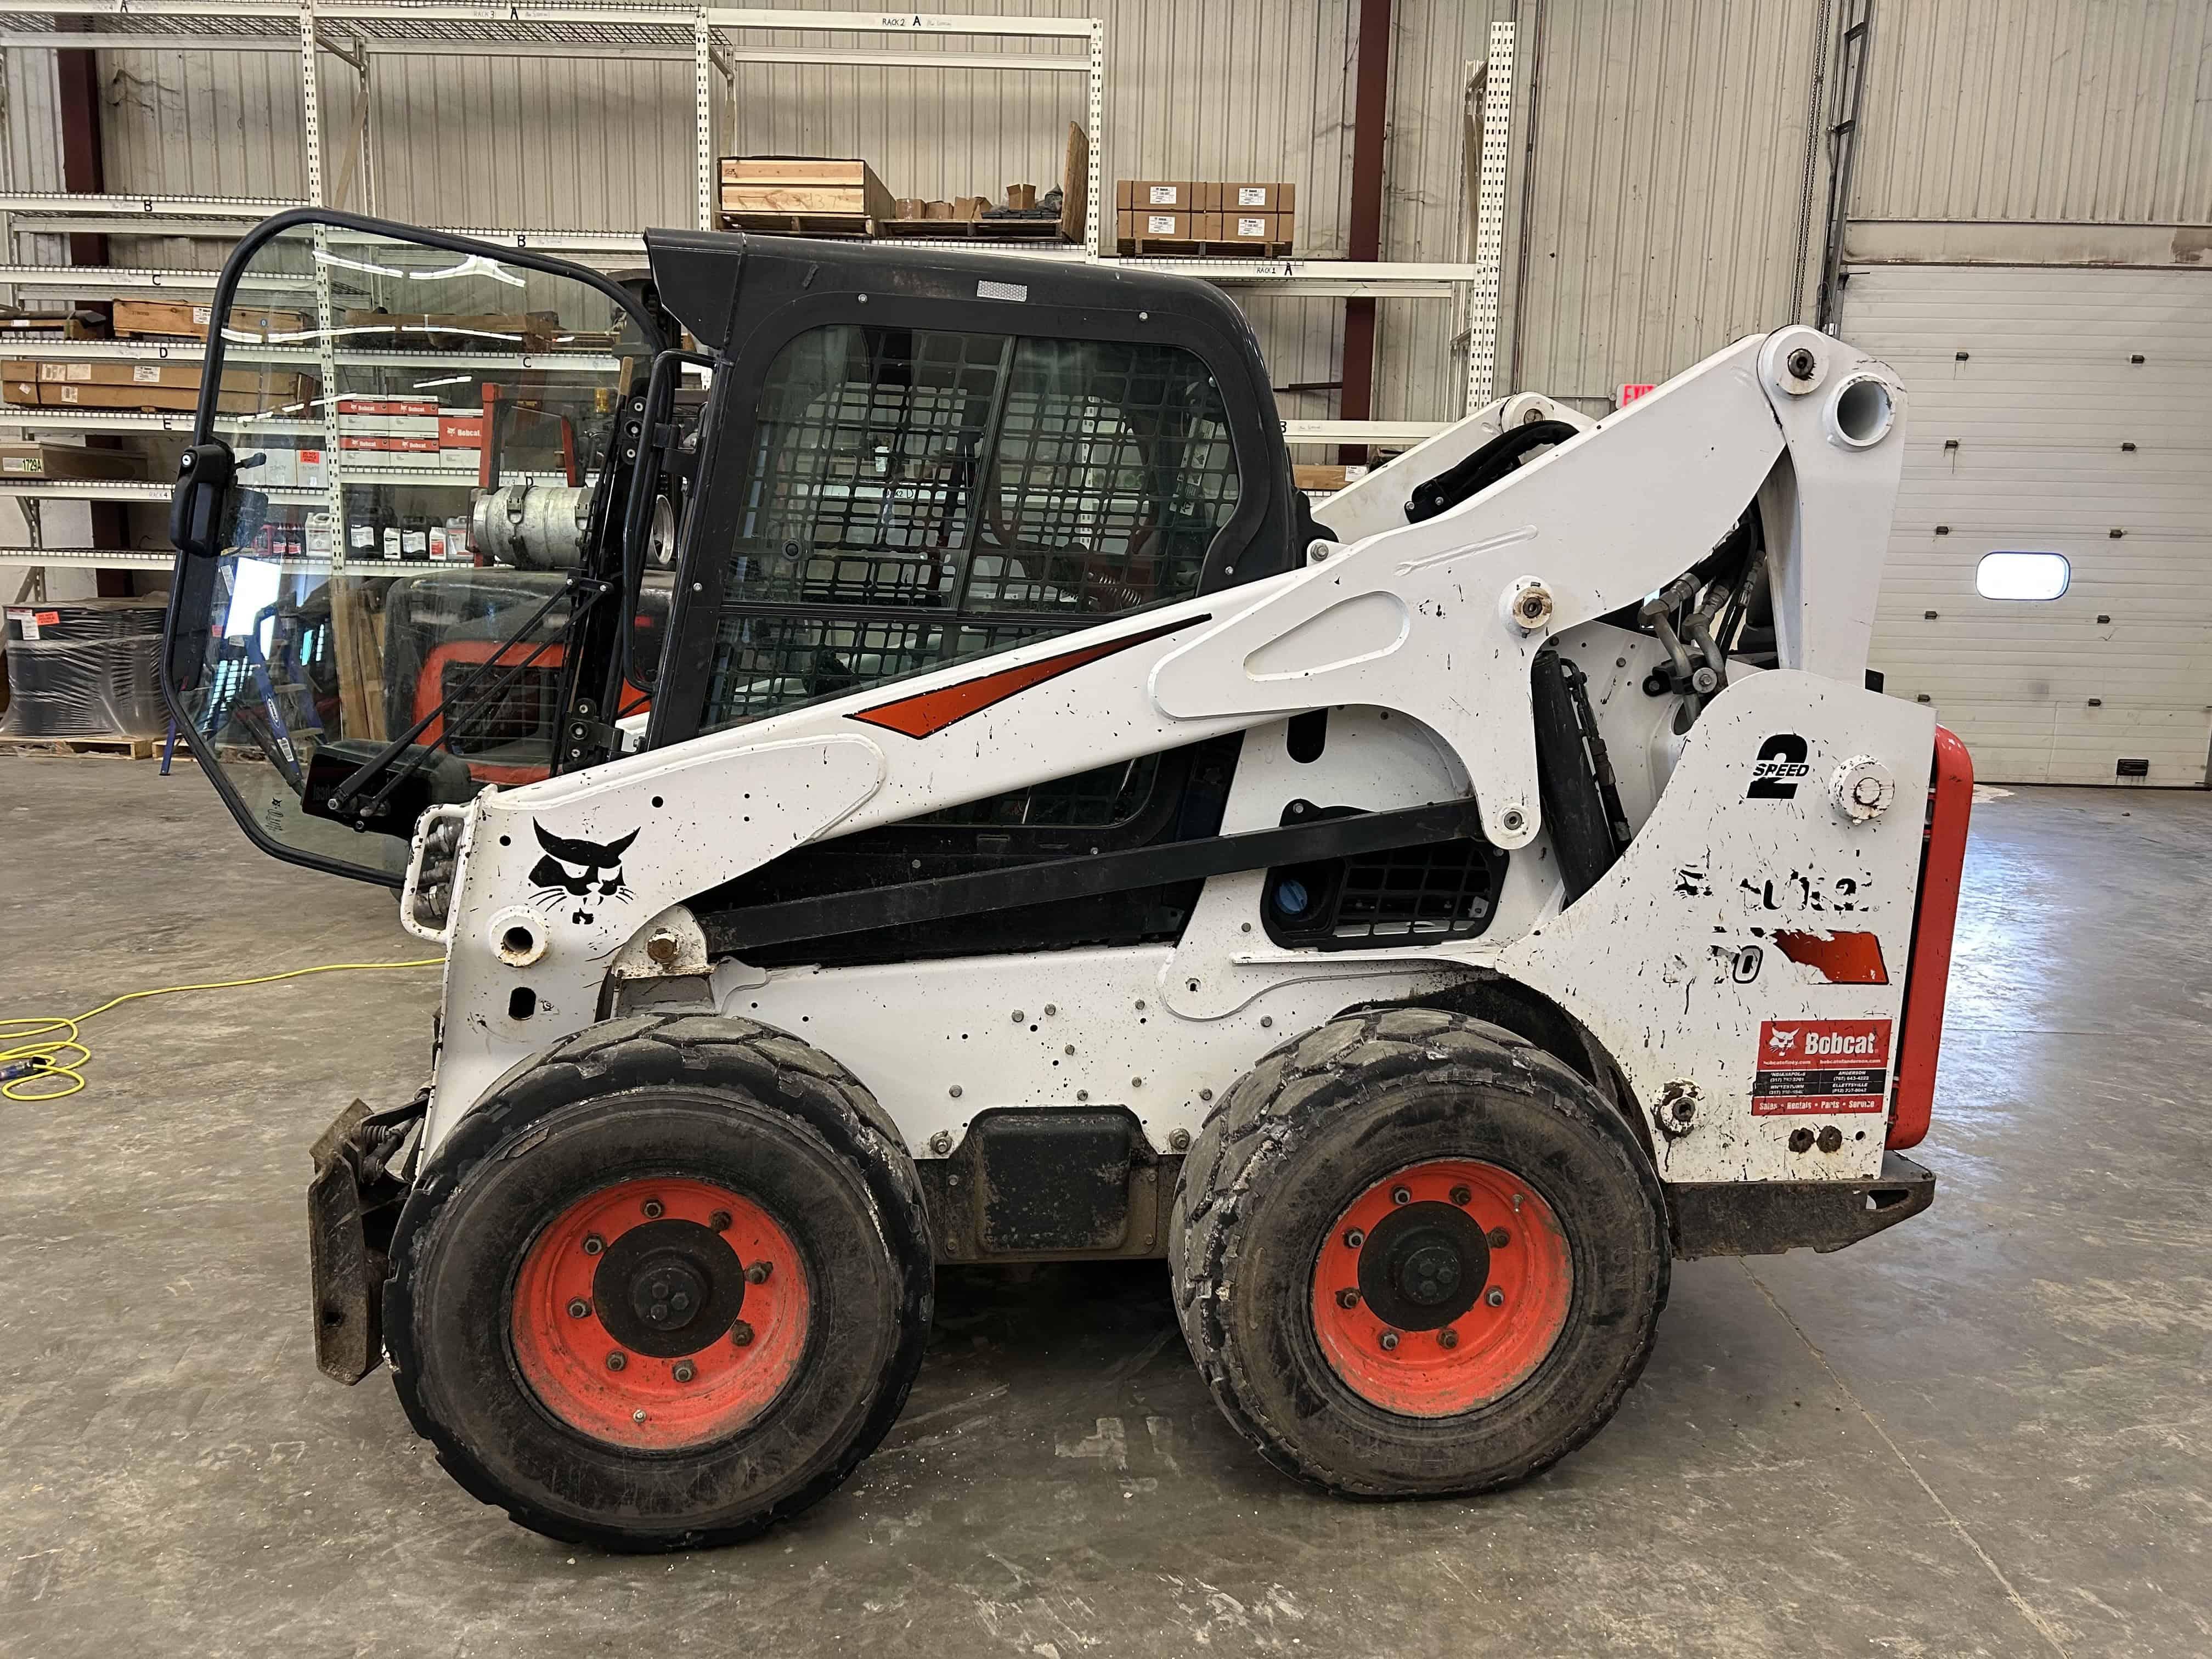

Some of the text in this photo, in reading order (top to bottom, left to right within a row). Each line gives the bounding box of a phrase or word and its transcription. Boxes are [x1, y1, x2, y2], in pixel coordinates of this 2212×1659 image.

[510, 7, 519, 20] A
[882, 18, 899, 26] RACK
[912, 15, 921, 26] A
[143, 200, 153, 212] B
[517, 235, 526, 247] B
[1284, 263, 1293, 276] A
[153, 274, 161, 286] C
[159, 347, 168, 358] D
[523, 357, 532, 368] C
[1623, 385, 1655, 408] EX
[163, 419, 172, 431] E
[1280, 421, 1287, 433] B
[458, 429, 481, 437] Bobcat
[22, 459, 42, 471] 1729A
[1746, 733, 1808, 799] 2
[1752, 763, 1810, 776] SPEED
[1804, 1032, 1876, 1055] Bobcat
[1759, 1100, 1875, 1110] Sales Rentals Parts Service
